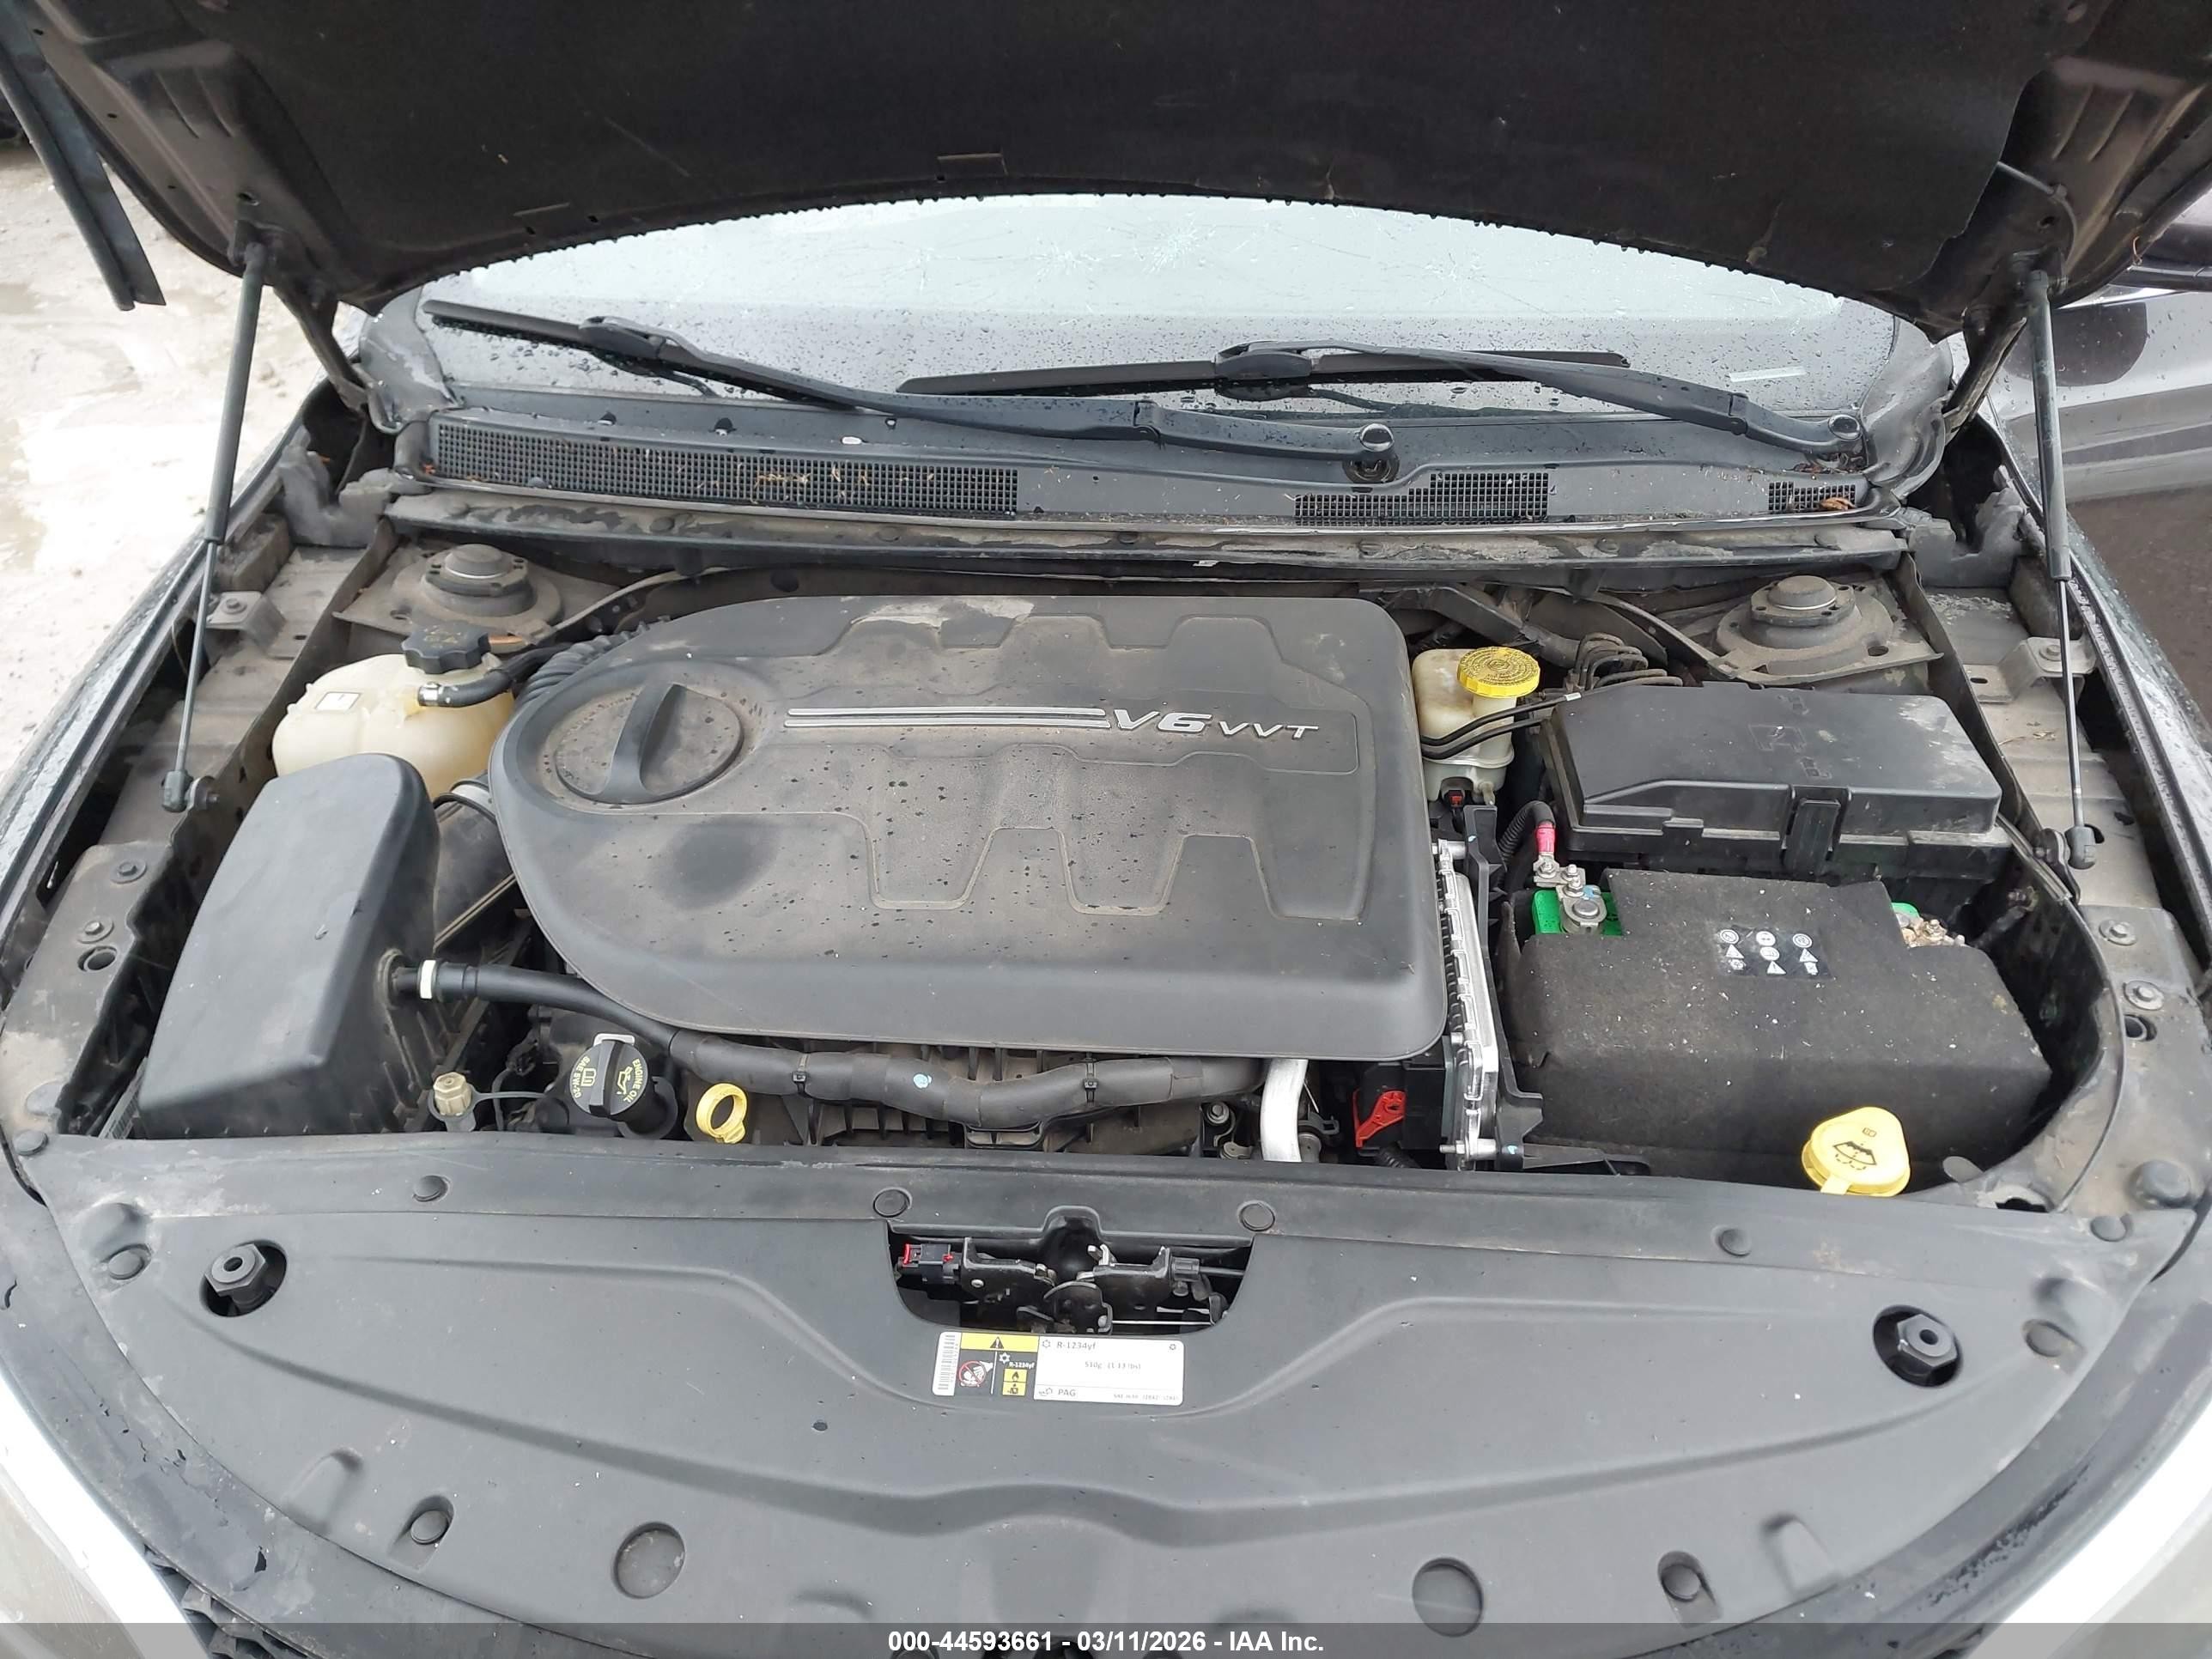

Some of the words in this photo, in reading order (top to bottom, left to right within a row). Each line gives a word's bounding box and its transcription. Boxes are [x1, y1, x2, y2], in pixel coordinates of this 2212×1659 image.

[1114, 708, 1212, 732] V6
[1218, 720, 1319, 738] VVT
[576, 1055, 591, 1072] SAE
[632, 1058, 644, 1090] ENGINE
[572, 1073, 582, 1098] 5W-20
[623, 1090, 637, 1103] OIL
[1056, 1340, 1097, 1351] R-1234yf
[1057, 1389, 1077, 1397] PAG
